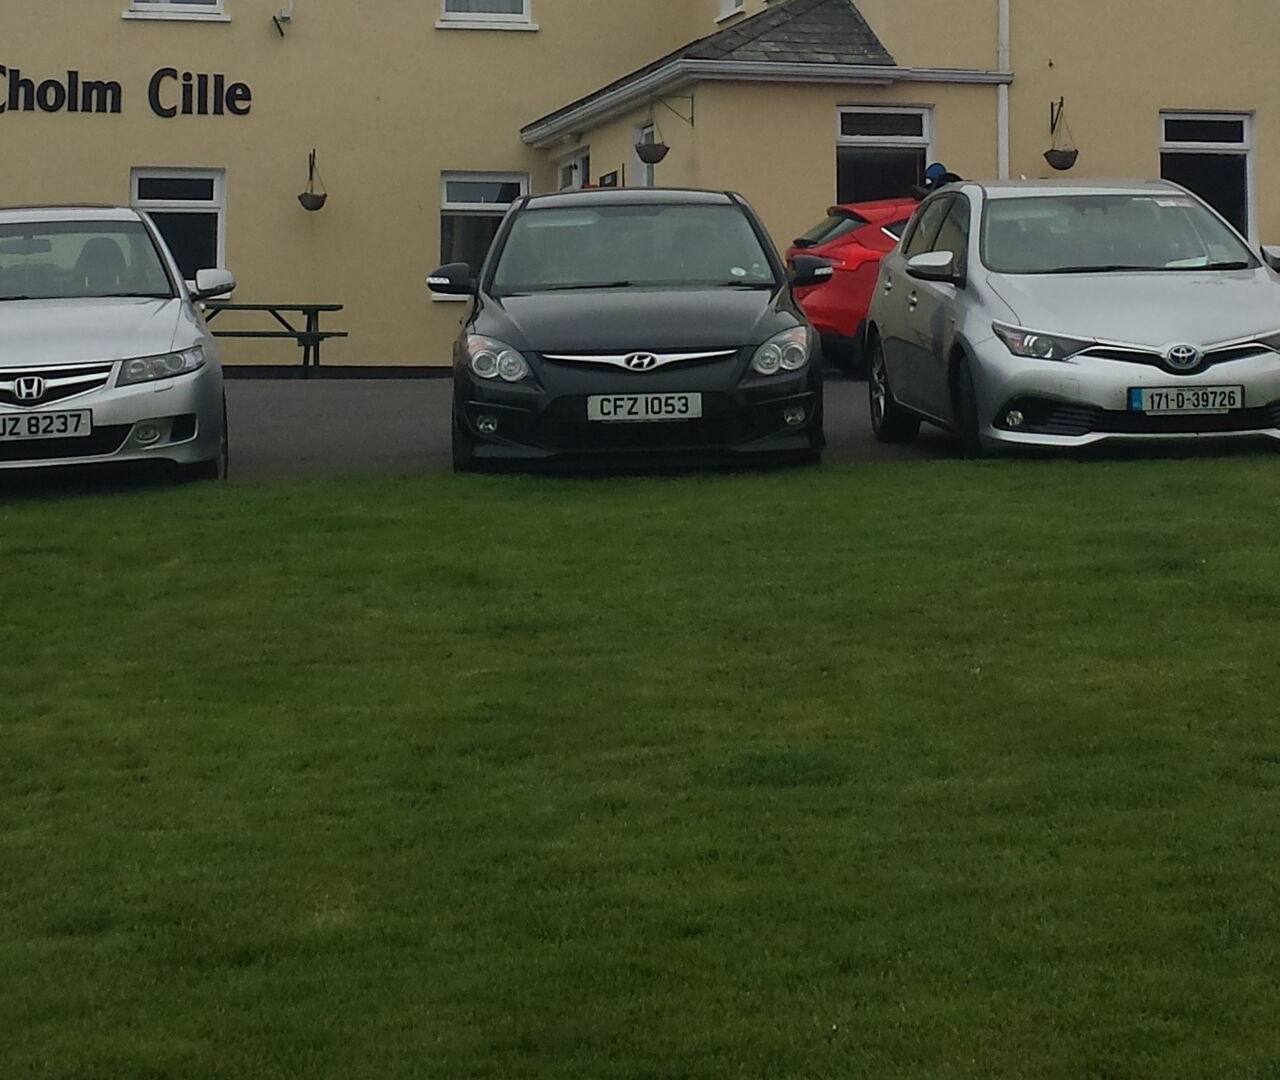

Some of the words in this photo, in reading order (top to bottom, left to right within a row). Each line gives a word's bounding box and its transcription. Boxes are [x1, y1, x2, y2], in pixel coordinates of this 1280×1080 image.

[147, 67, 252, 118] Cille
[600, 397, 639, 416] CFZ
[644, 396, 689, 415] 1053
[1149, 390, 1237, 409] 171-D-39726
[27, 413, 82, 435] 8237
